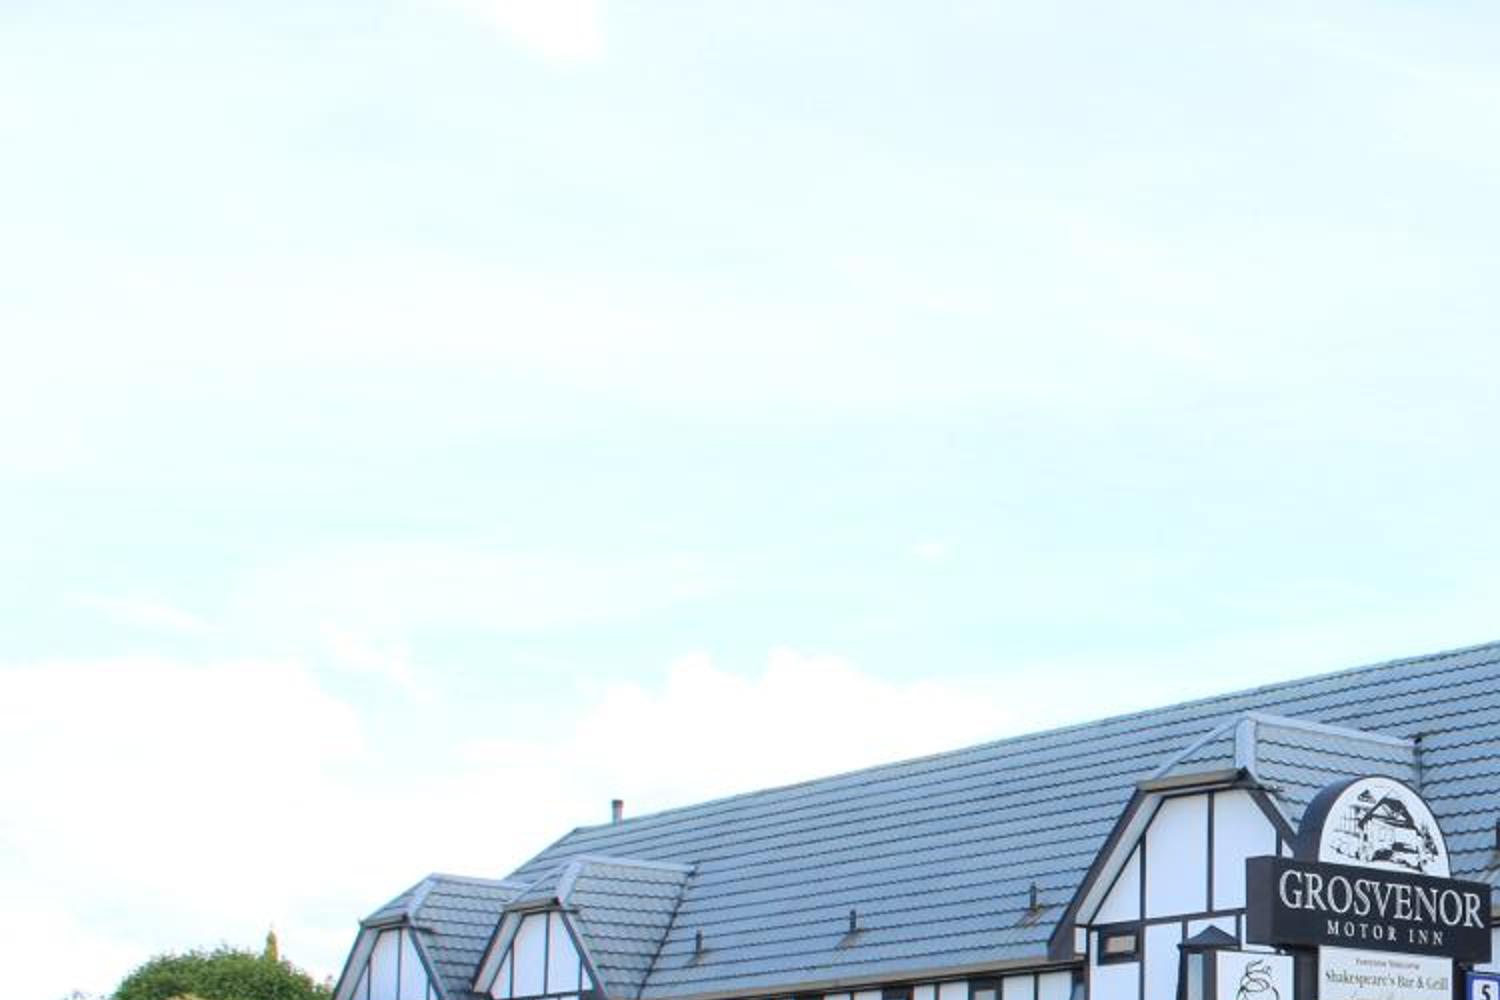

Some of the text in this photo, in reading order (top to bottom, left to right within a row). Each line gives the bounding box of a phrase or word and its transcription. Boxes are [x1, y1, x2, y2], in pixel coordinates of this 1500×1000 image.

[1279, 869, 1484, 928] GROSVENOR
[1327, 920, 1444, 945] MOTOR INN
